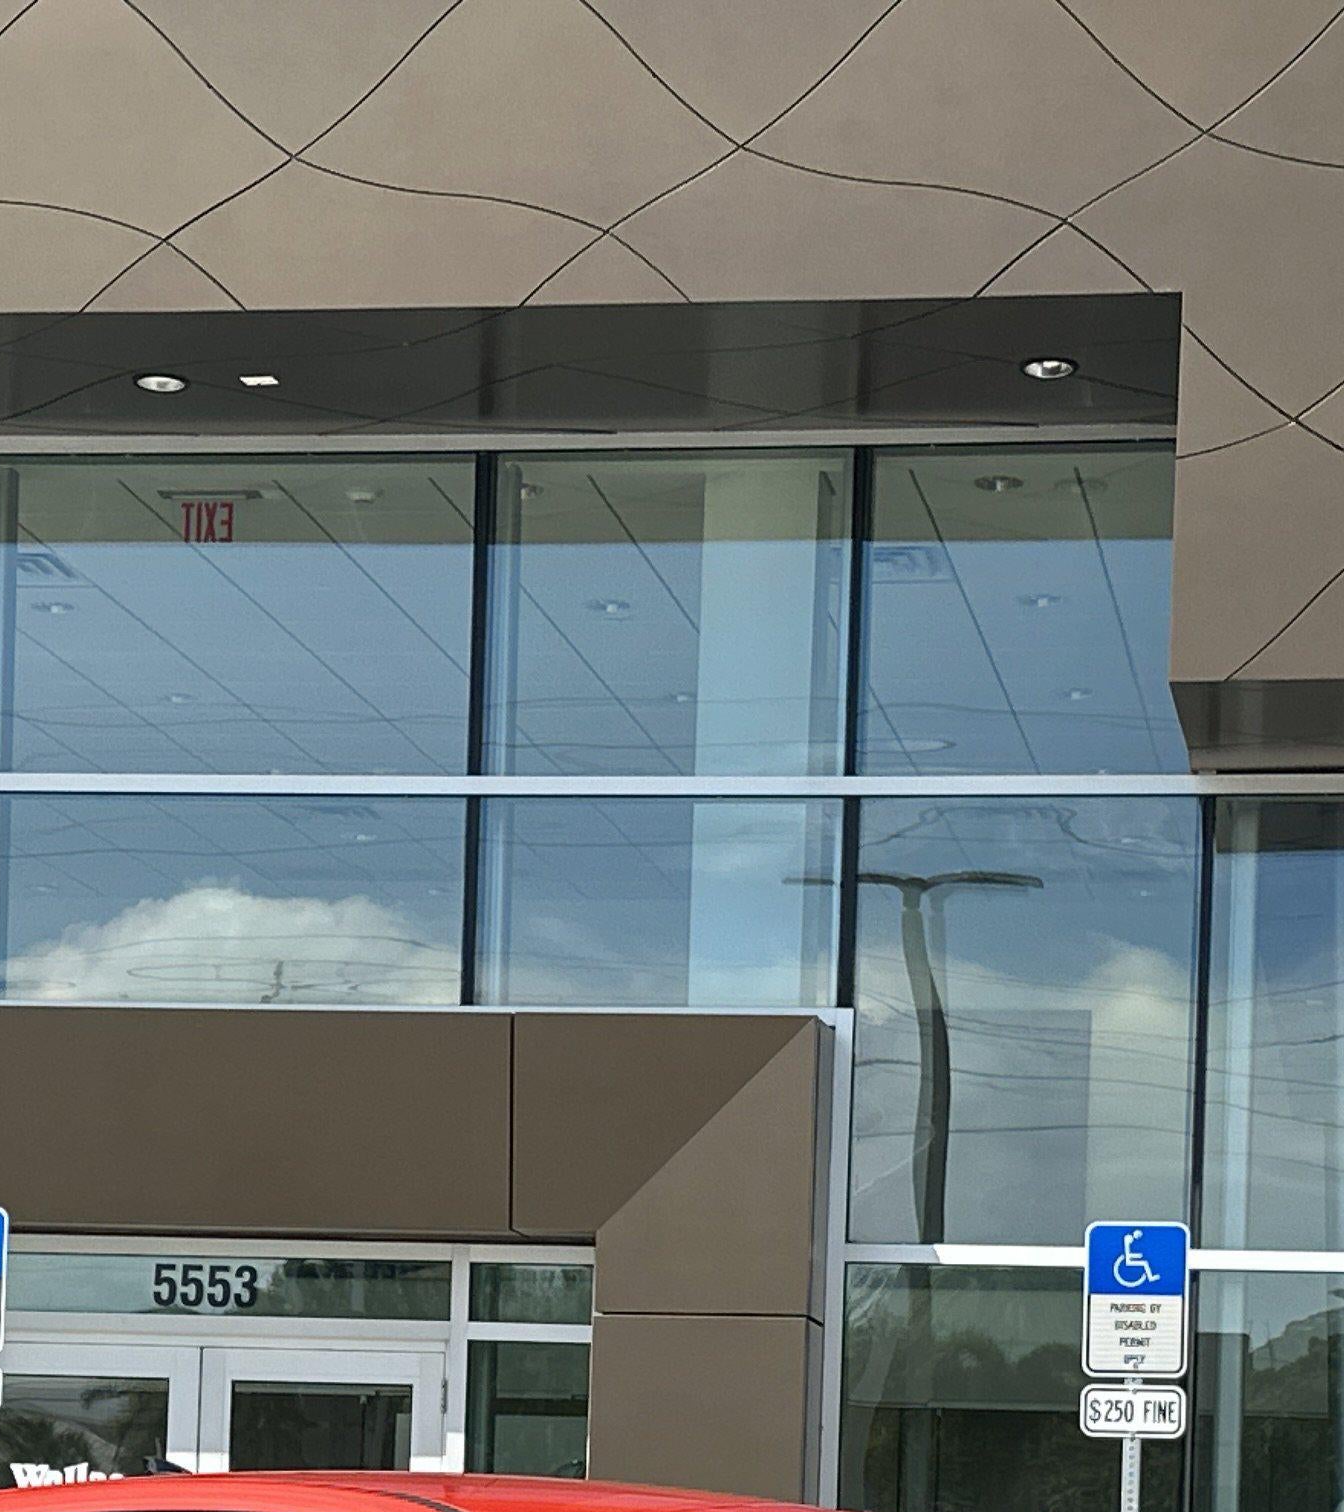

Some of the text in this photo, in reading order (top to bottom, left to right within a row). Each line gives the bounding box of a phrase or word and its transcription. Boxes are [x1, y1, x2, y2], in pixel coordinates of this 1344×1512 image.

[154, 1263, 258, 1308] 5553
[1089, 1398, 1177, 1424] $250 FINE
